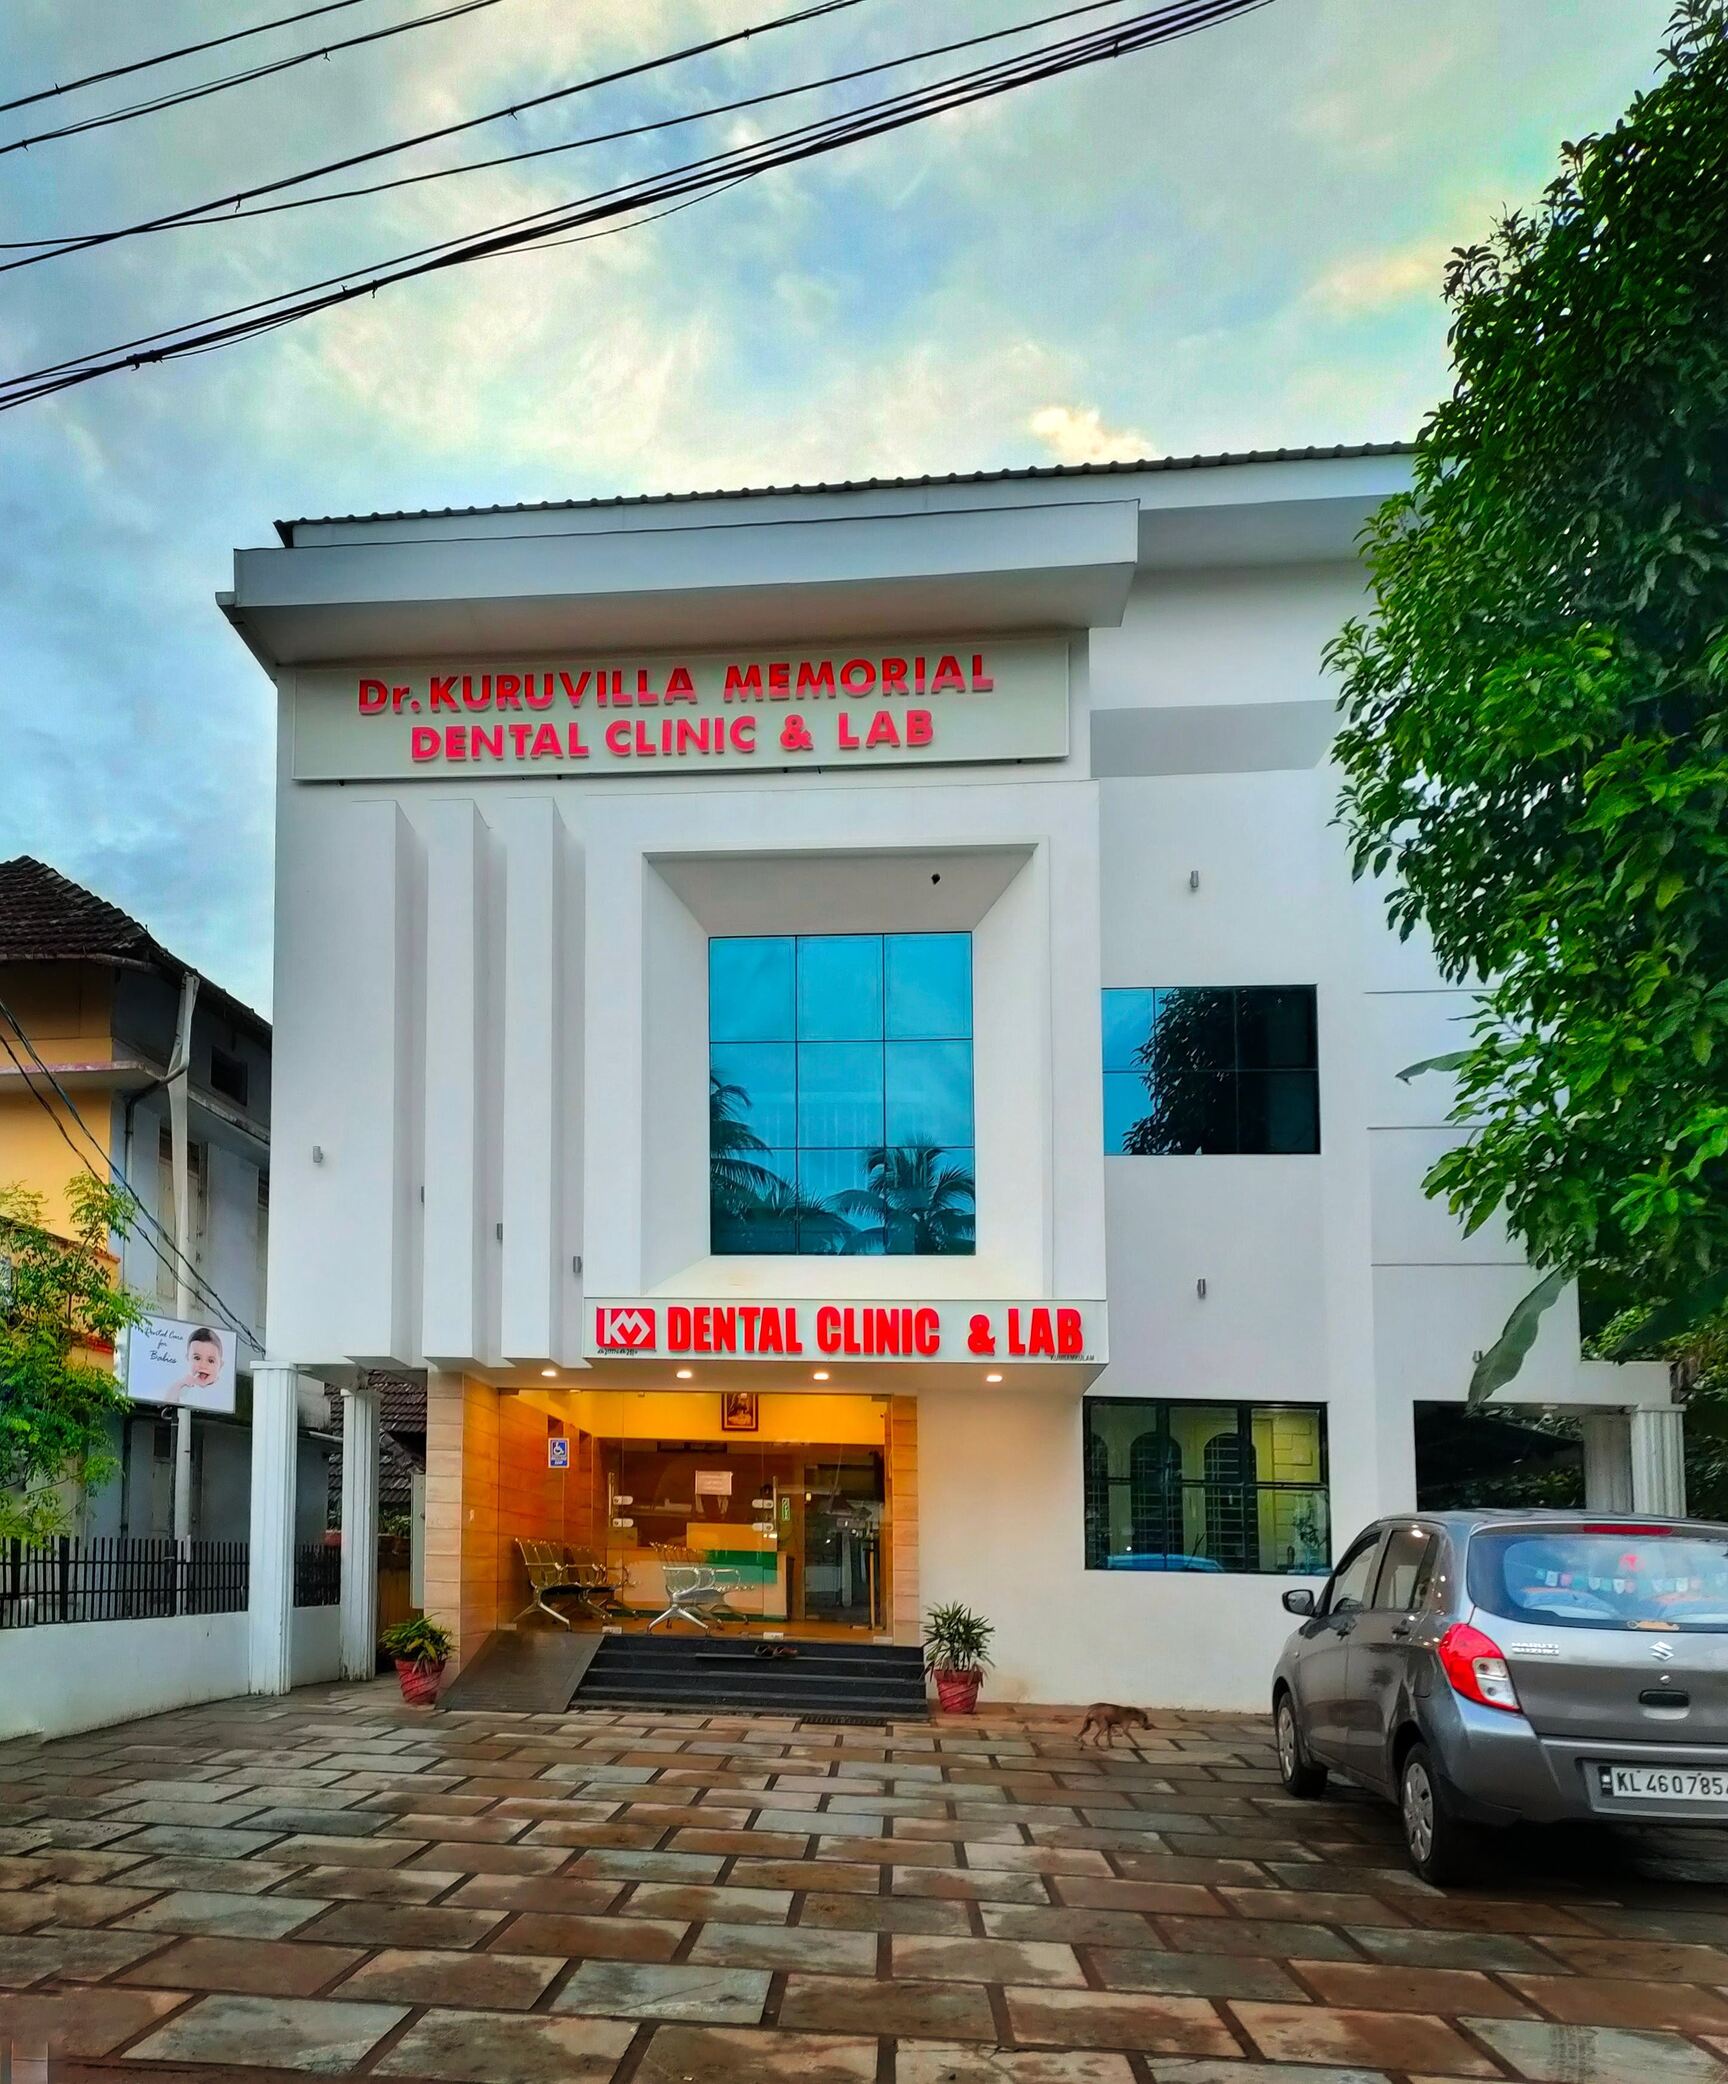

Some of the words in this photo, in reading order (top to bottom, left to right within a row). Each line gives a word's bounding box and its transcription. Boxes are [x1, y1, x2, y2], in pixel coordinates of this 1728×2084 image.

[723, 654, 994, 703] MEMORIAL
[411, 722, 591, 763] DENTAL
[605, 715, 757, 757] CLINIC
[780, 714, 814, 751] &
[838, 709, 935, 749] LAB
[157, 1339, 167, 1350] for
[667, 1306, 803, 1354] DENTAL
[816, 1306, 940, 1356] CLINIC
[967, 1314, 996, 1356] &
[1007, 1307, 1084, 1356] LAB
